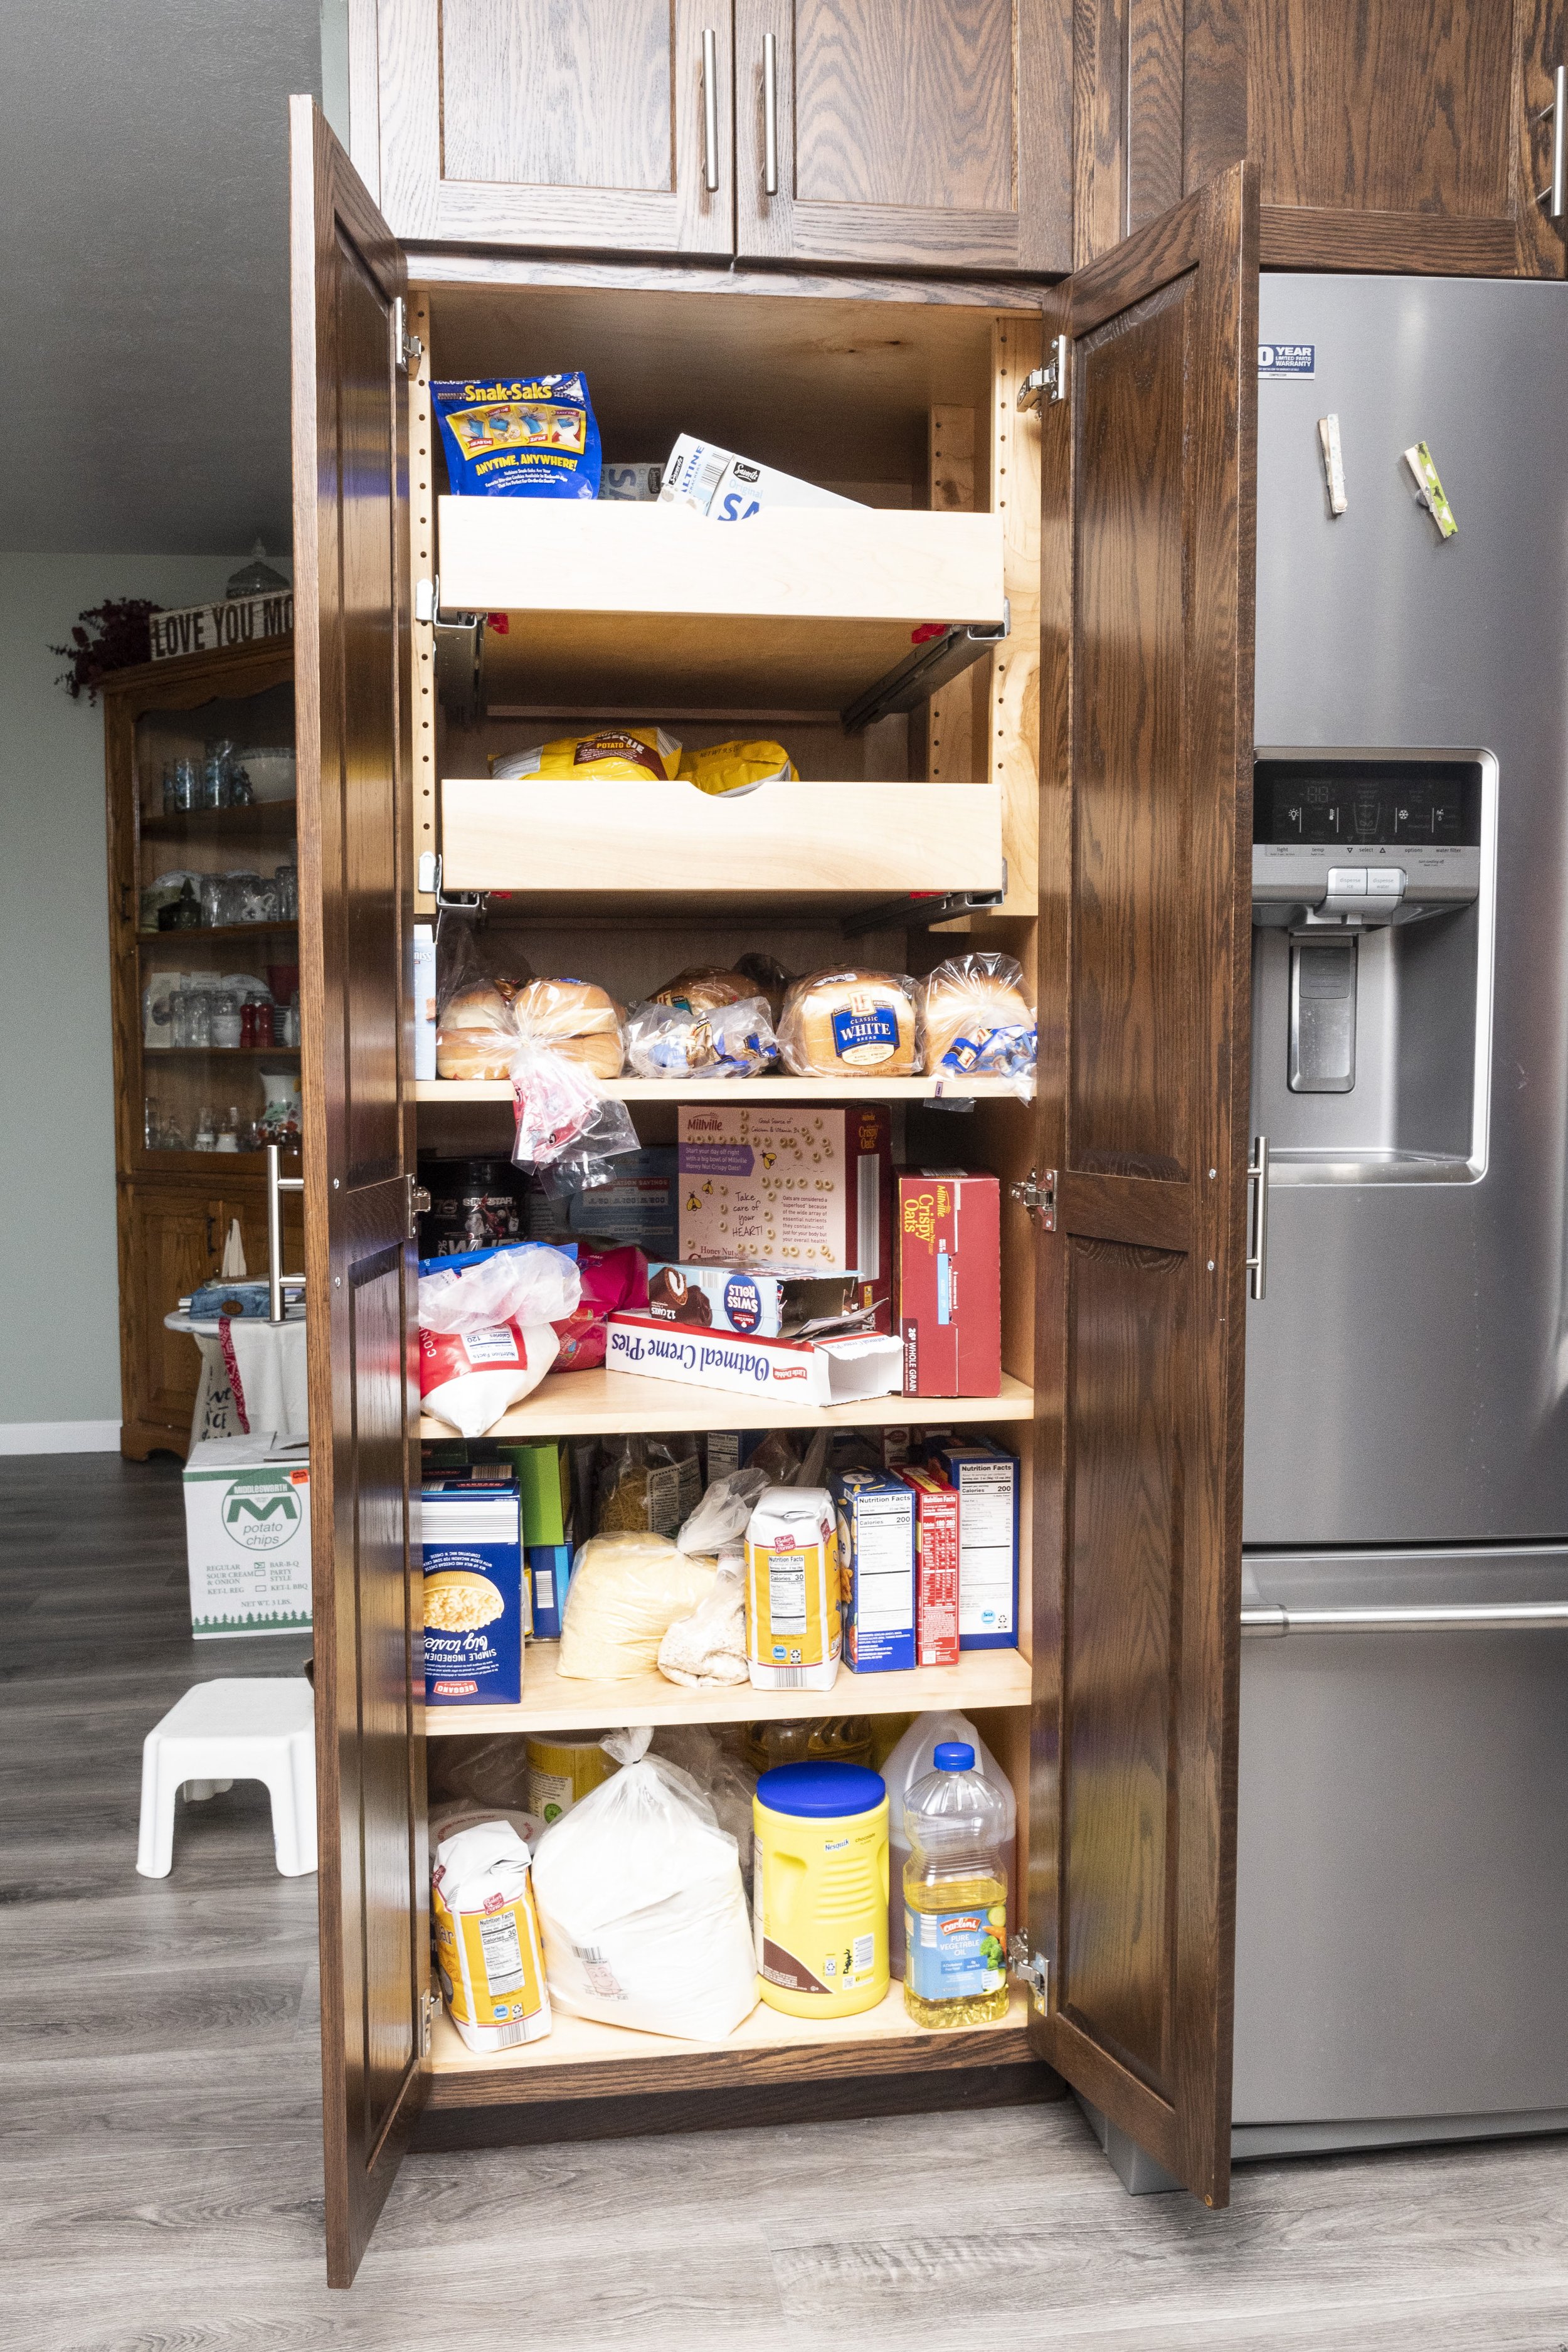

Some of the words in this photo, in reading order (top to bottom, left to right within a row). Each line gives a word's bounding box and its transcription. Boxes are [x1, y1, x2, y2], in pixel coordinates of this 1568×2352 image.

[1258, 346, 1274, 366] 0
[1276, 346, 1312, 356] YEAR
[464, 383, 552, 401] Snak-Saks
[475, 455, 519, 476] ANYTIME,
[521, 453, 578, 472] ANYWHERE!
[729, 478, 763, 499] Original
[153, 612, 204, 657] LOVE
[212, 603, 252, 646] YOU
[840, 1023, 891, 1041] WHITE
[687, 1119, 723, 1130] Millville
[858, 1126, 877, 1139] Crispy
[861, 1137, 874, 1149] Oats
[735, 1192, 756, 1202] Take
[937, 1185, 946, 1218] Millville
[752, 1200, 761, 1211] of
[739, 1214, 755, 1226] your
[903, 1199, 919, 1233] Oats
[914, 1194, 935, 1242] Crispy
[733, 1225, 763, 1237] HEART!
[700, 1246, 721, 1254] Honey
[721, 1248, 734, 1256] Nut
[728, 1285, 756, 1298] ROLLS
[727, 1296, 758, 1313] SWISS
[651, 1307, 667, 1316] CAKES
[666, 1310, 676, 1320] 12
[611, 1333, 645, 1360] Pies
[647, 1339, 696, 1370] Creme
[700, 1347, 770, 1381] Oatmeal
[774, 1370, 793, 1379] Debbie
[792, 1369, 807, 1378] Little
[909, 1369, 917, 1392] GRAIN
[226, 1496, 299, 1523] M
[243, 1522, 283, 1536] potato
[246, 1535, 279, 1547] chips
[776, 1537, 793, 1545] Baker's
[776, 1544, 795, 1554] Corner
[423, 1636, 462, 1653] taste.
[463, 1632, 488, 1651] big
[469, 1648, 497, 1661] SIMPLE
[437, 1685, 475, 1693] REGGANO
[824, 1838, 849, 1851] Nesquik
[855, 1833, 876, 1843] chocolate
[480, 1917, 501, 1926] Nutrition
[943, 1917, 977, 1932] carlini
[483, 1936, 504, 1944] Calories
[508, 1929, 516, 1937] 30
[951, 1934, 970, 1942] PURE
[940, 1939, 980, 1951] VEGETABLE
